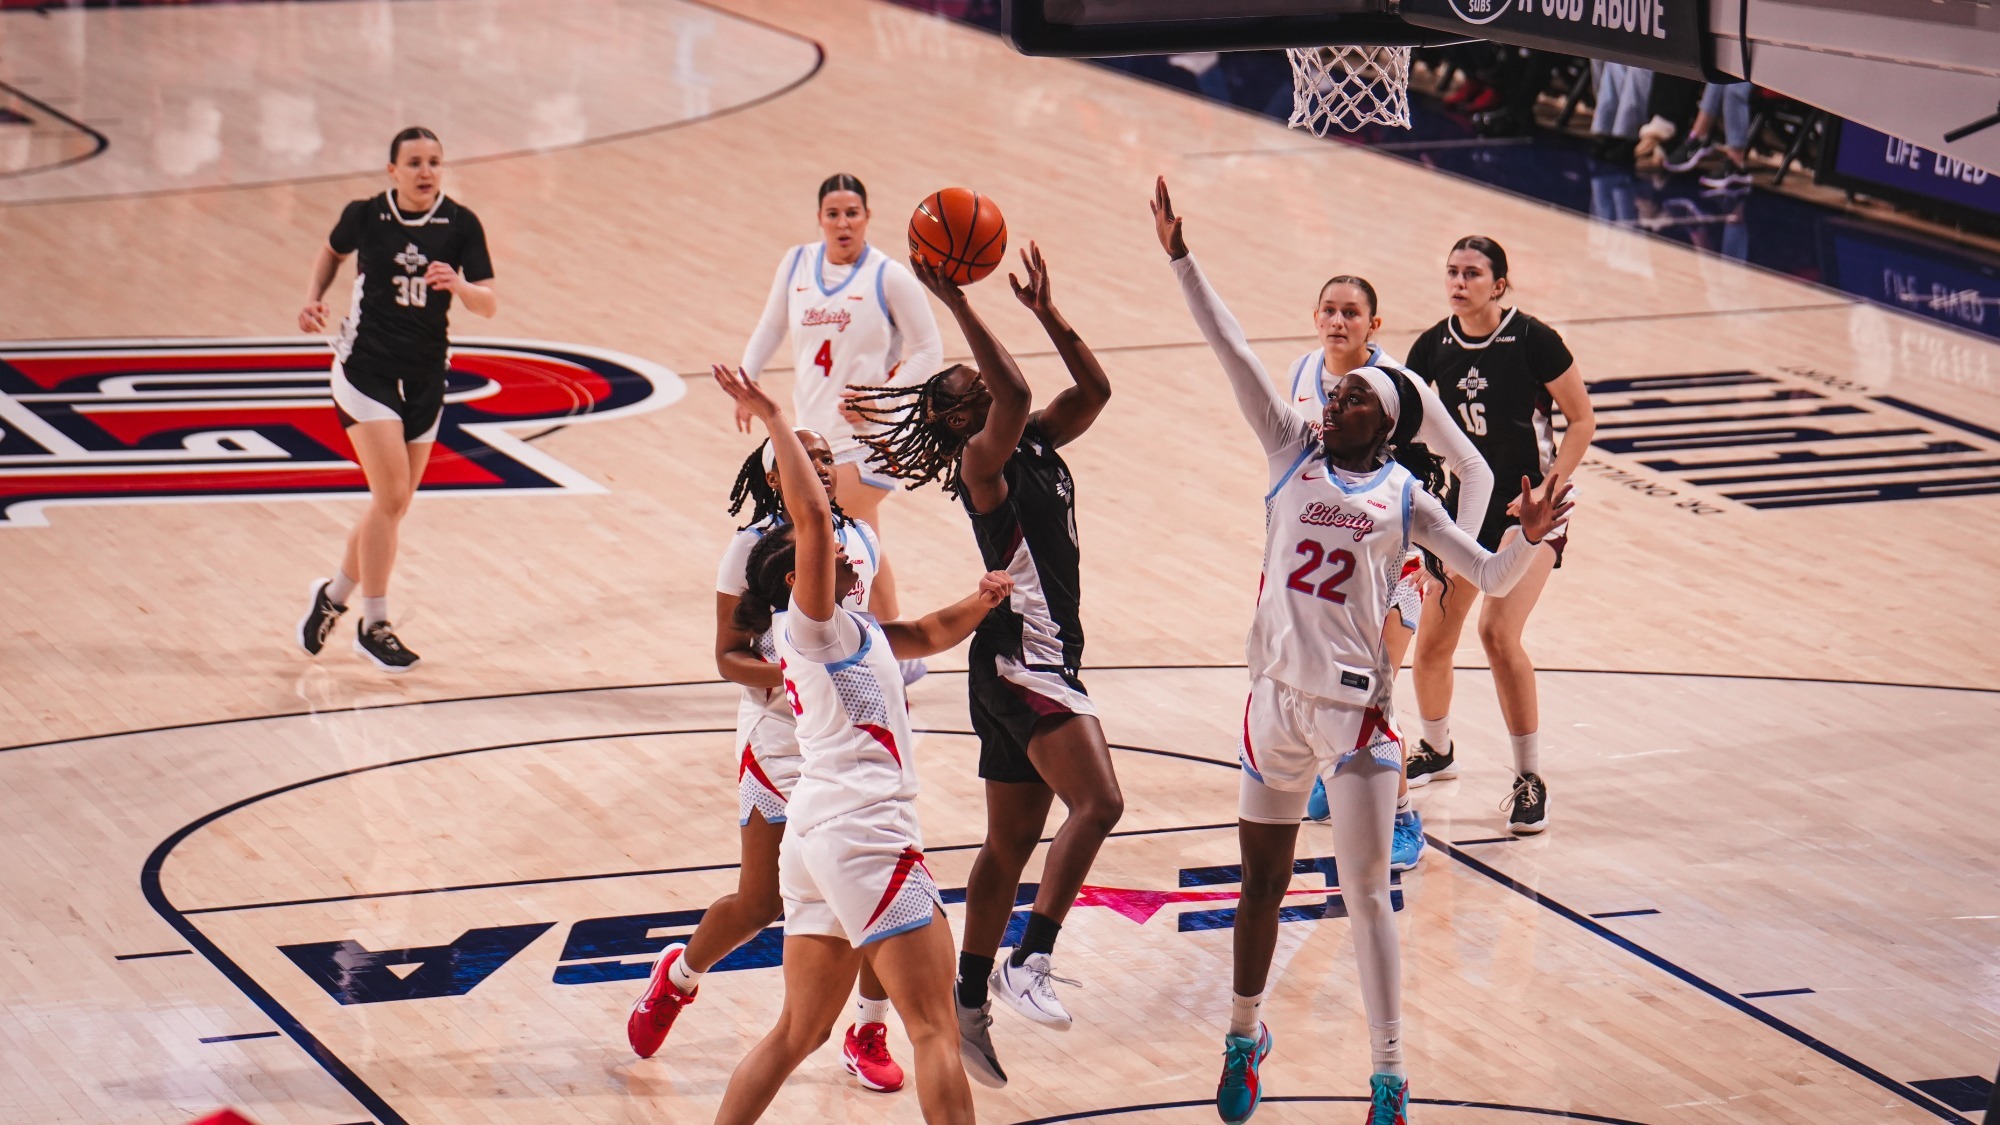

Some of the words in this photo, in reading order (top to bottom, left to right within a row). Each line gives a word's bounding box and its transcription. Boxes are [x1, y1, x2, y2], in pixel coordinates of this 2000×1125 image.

[1592, 0, 1665, 39] ABOVE
[1885, 136, 1920, 170] LIFE
[392, 275, 428, 307] 30
[802, 308, 851, 332] Liberty
[814, 339, 833, 377] 4
[1457, 402, 1488, 435] 16
[1300, 502, 1374, 542] Liberty
[1286, 538, 1357, 606] 22
